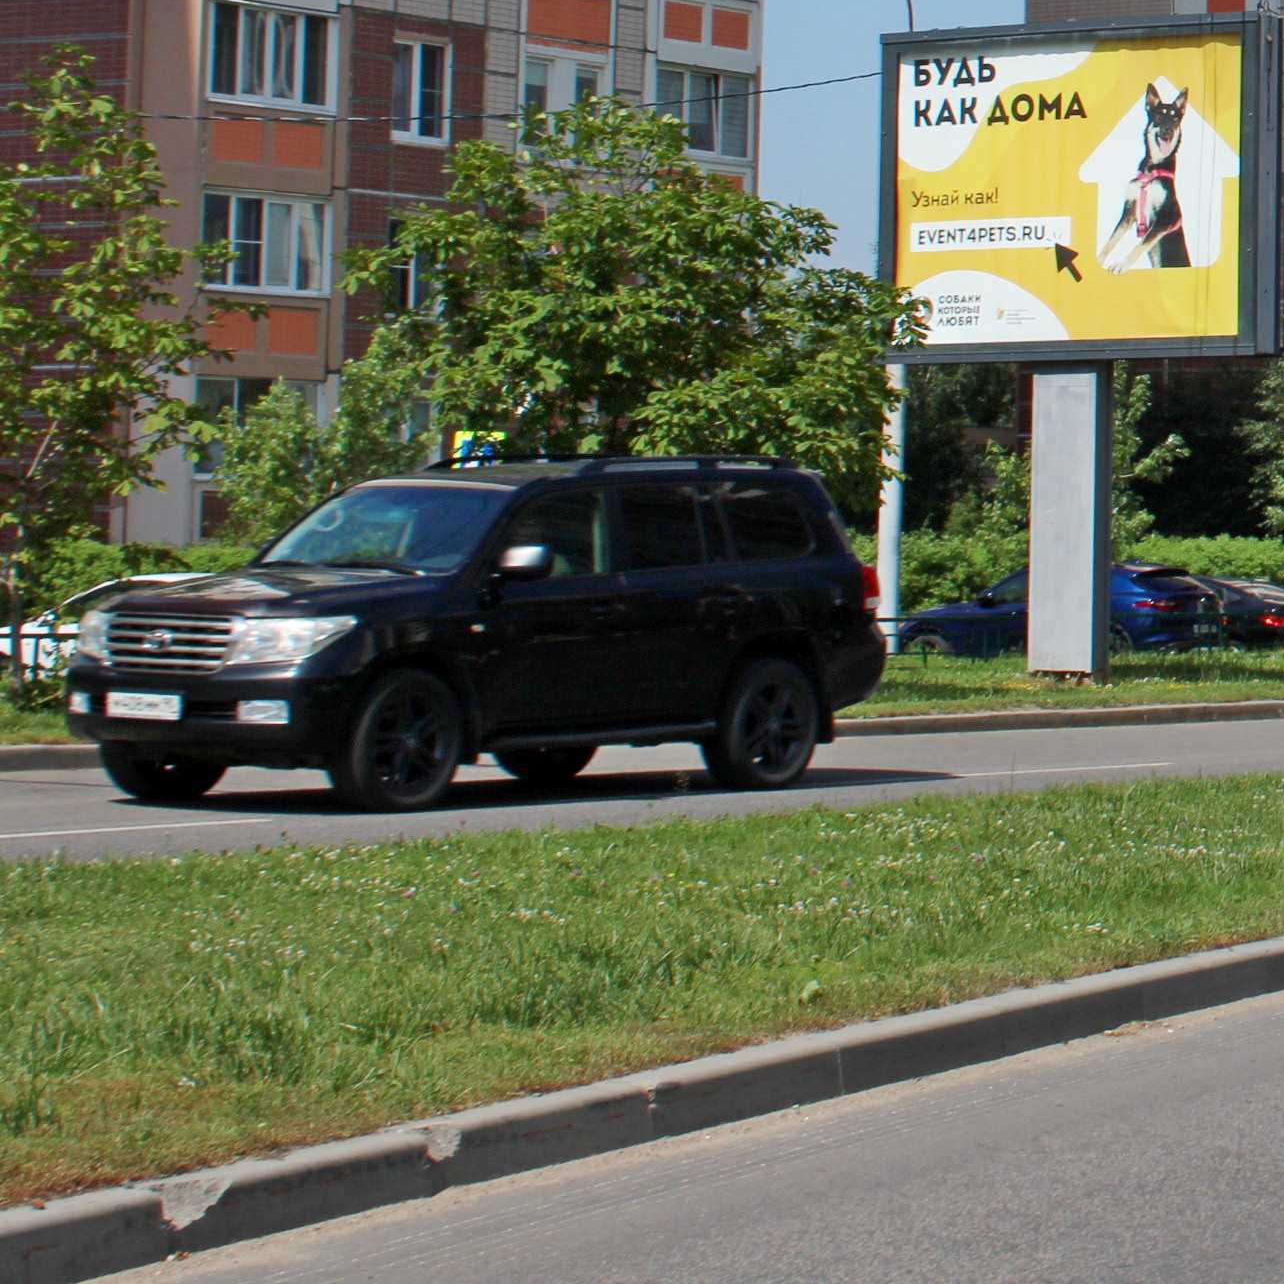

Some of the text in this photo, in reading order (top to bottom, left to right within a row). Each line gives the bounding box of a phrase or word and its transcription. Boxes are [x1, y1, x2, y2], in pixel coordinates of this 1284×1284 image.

[914, 56, 996, 87] БУДЬ
[914, 91, 1087, 127] КАК ДОМА
[912, 187, 999, 208] Узнай как!
[918, 225, 1046, 245] EVENT4PETS.RU
[938, 294, 982, 304] СОБАКИ
[937, 316, 980, 327] ЛЮБЯТ
